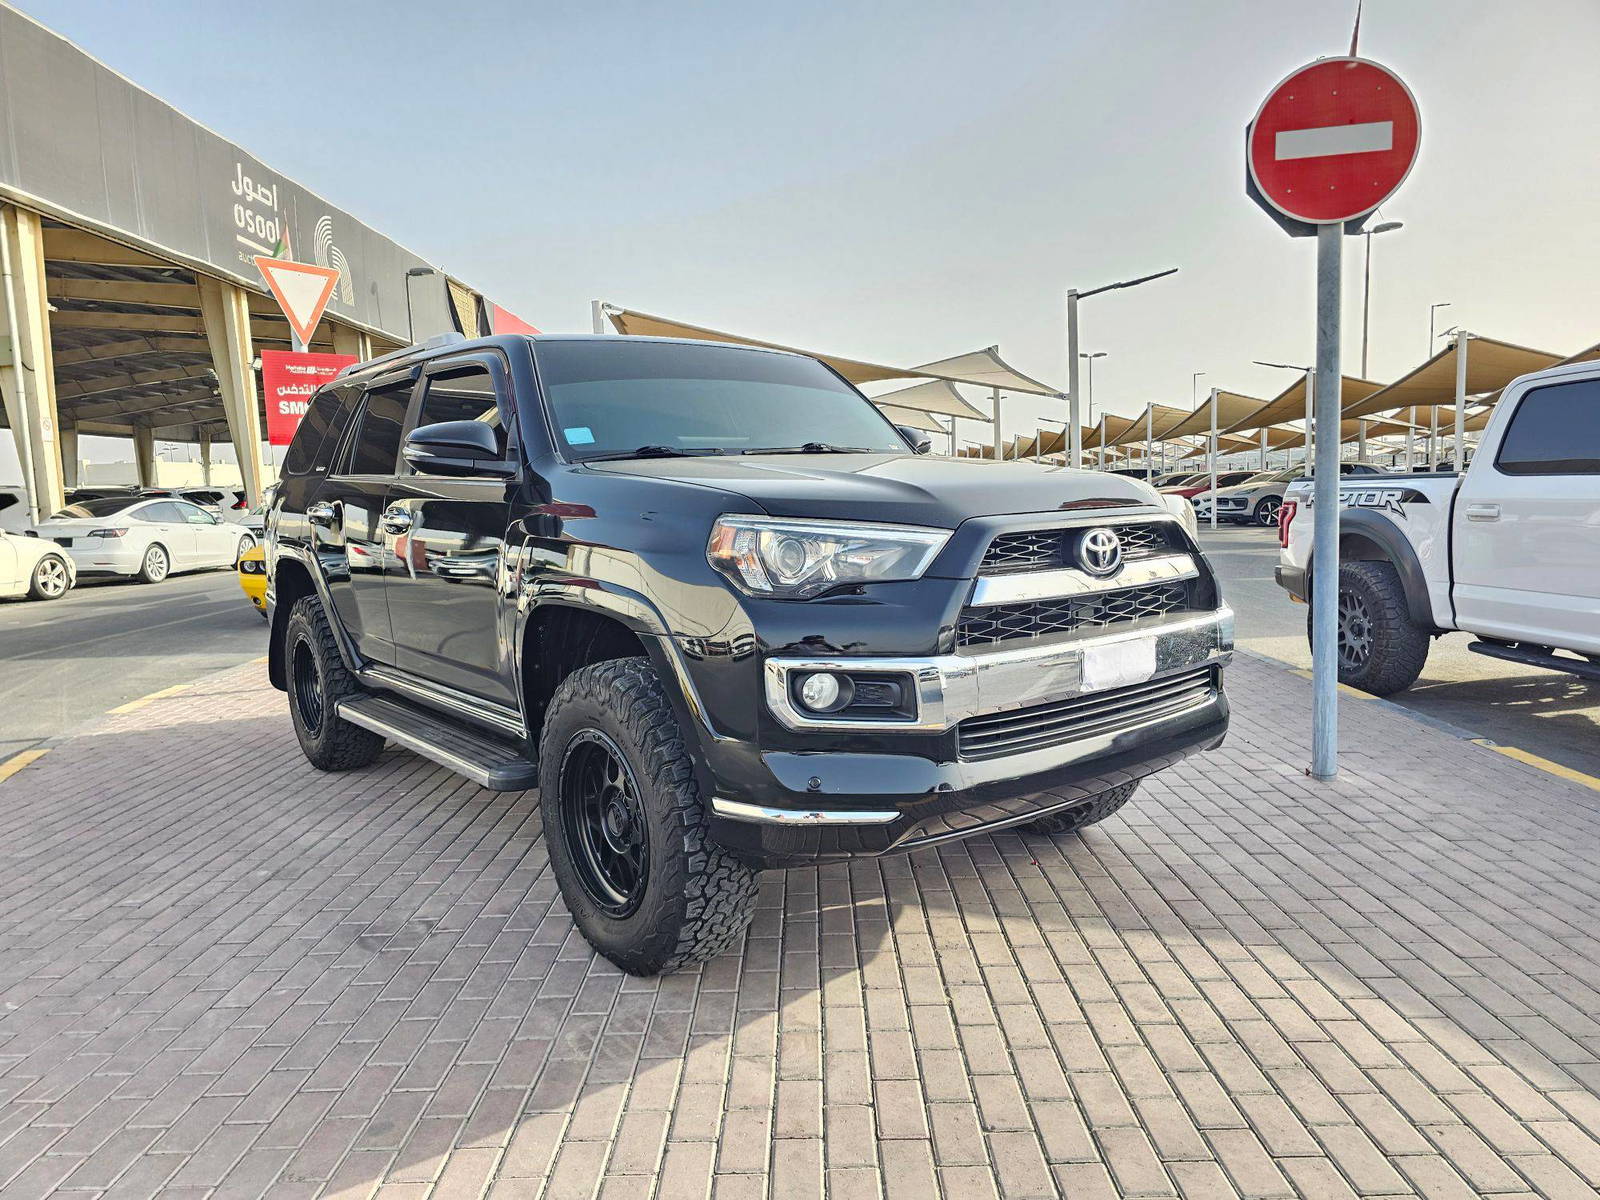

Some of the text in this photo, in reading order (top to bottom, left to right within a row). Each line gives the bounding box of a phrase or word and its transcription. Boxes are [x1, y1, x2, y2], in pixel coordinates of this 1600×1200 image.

[231, 162, 278, 212] اصول
[233, 203, 280, 244] osool
[278, 400, 309, 415] SM
